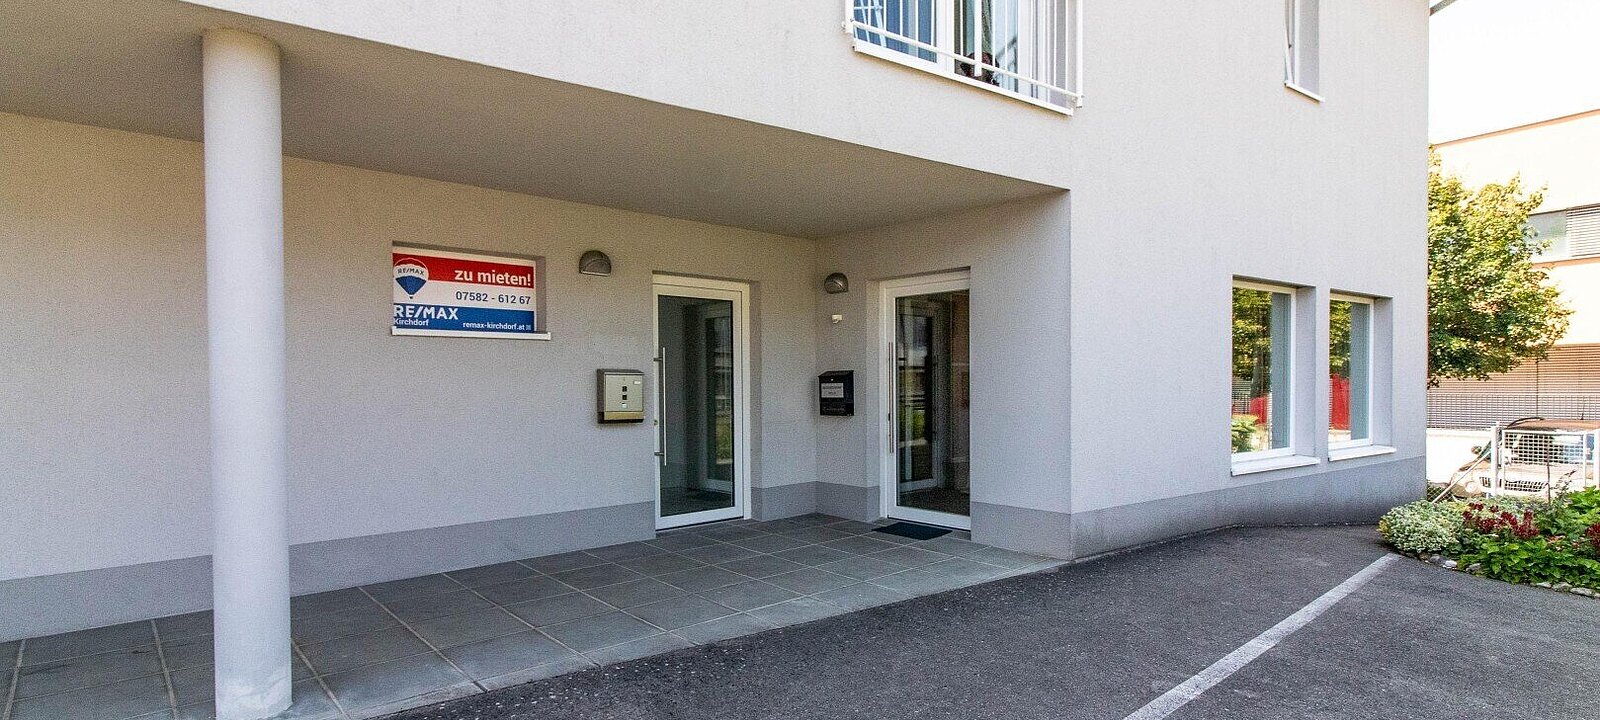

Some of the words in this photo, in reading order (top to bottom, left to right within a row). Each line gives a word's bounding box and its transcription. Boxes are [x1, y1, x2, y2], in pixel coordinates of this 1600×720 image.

[398, 267, 425, 276] RE/MAX
[454, 270, 473, 281] zu
[477, 270, 531, 286] mieten!
[455, 291, 489, 302] 07582
[498, 293, 517, 304] 612
[519, 295, 531, 305] 67
[393, 304, 459, 320] RE/MAX
[393, 318, 429, 326] Kirchdorf
[462, 321, 525, 331] remax-kirchdorf.at
